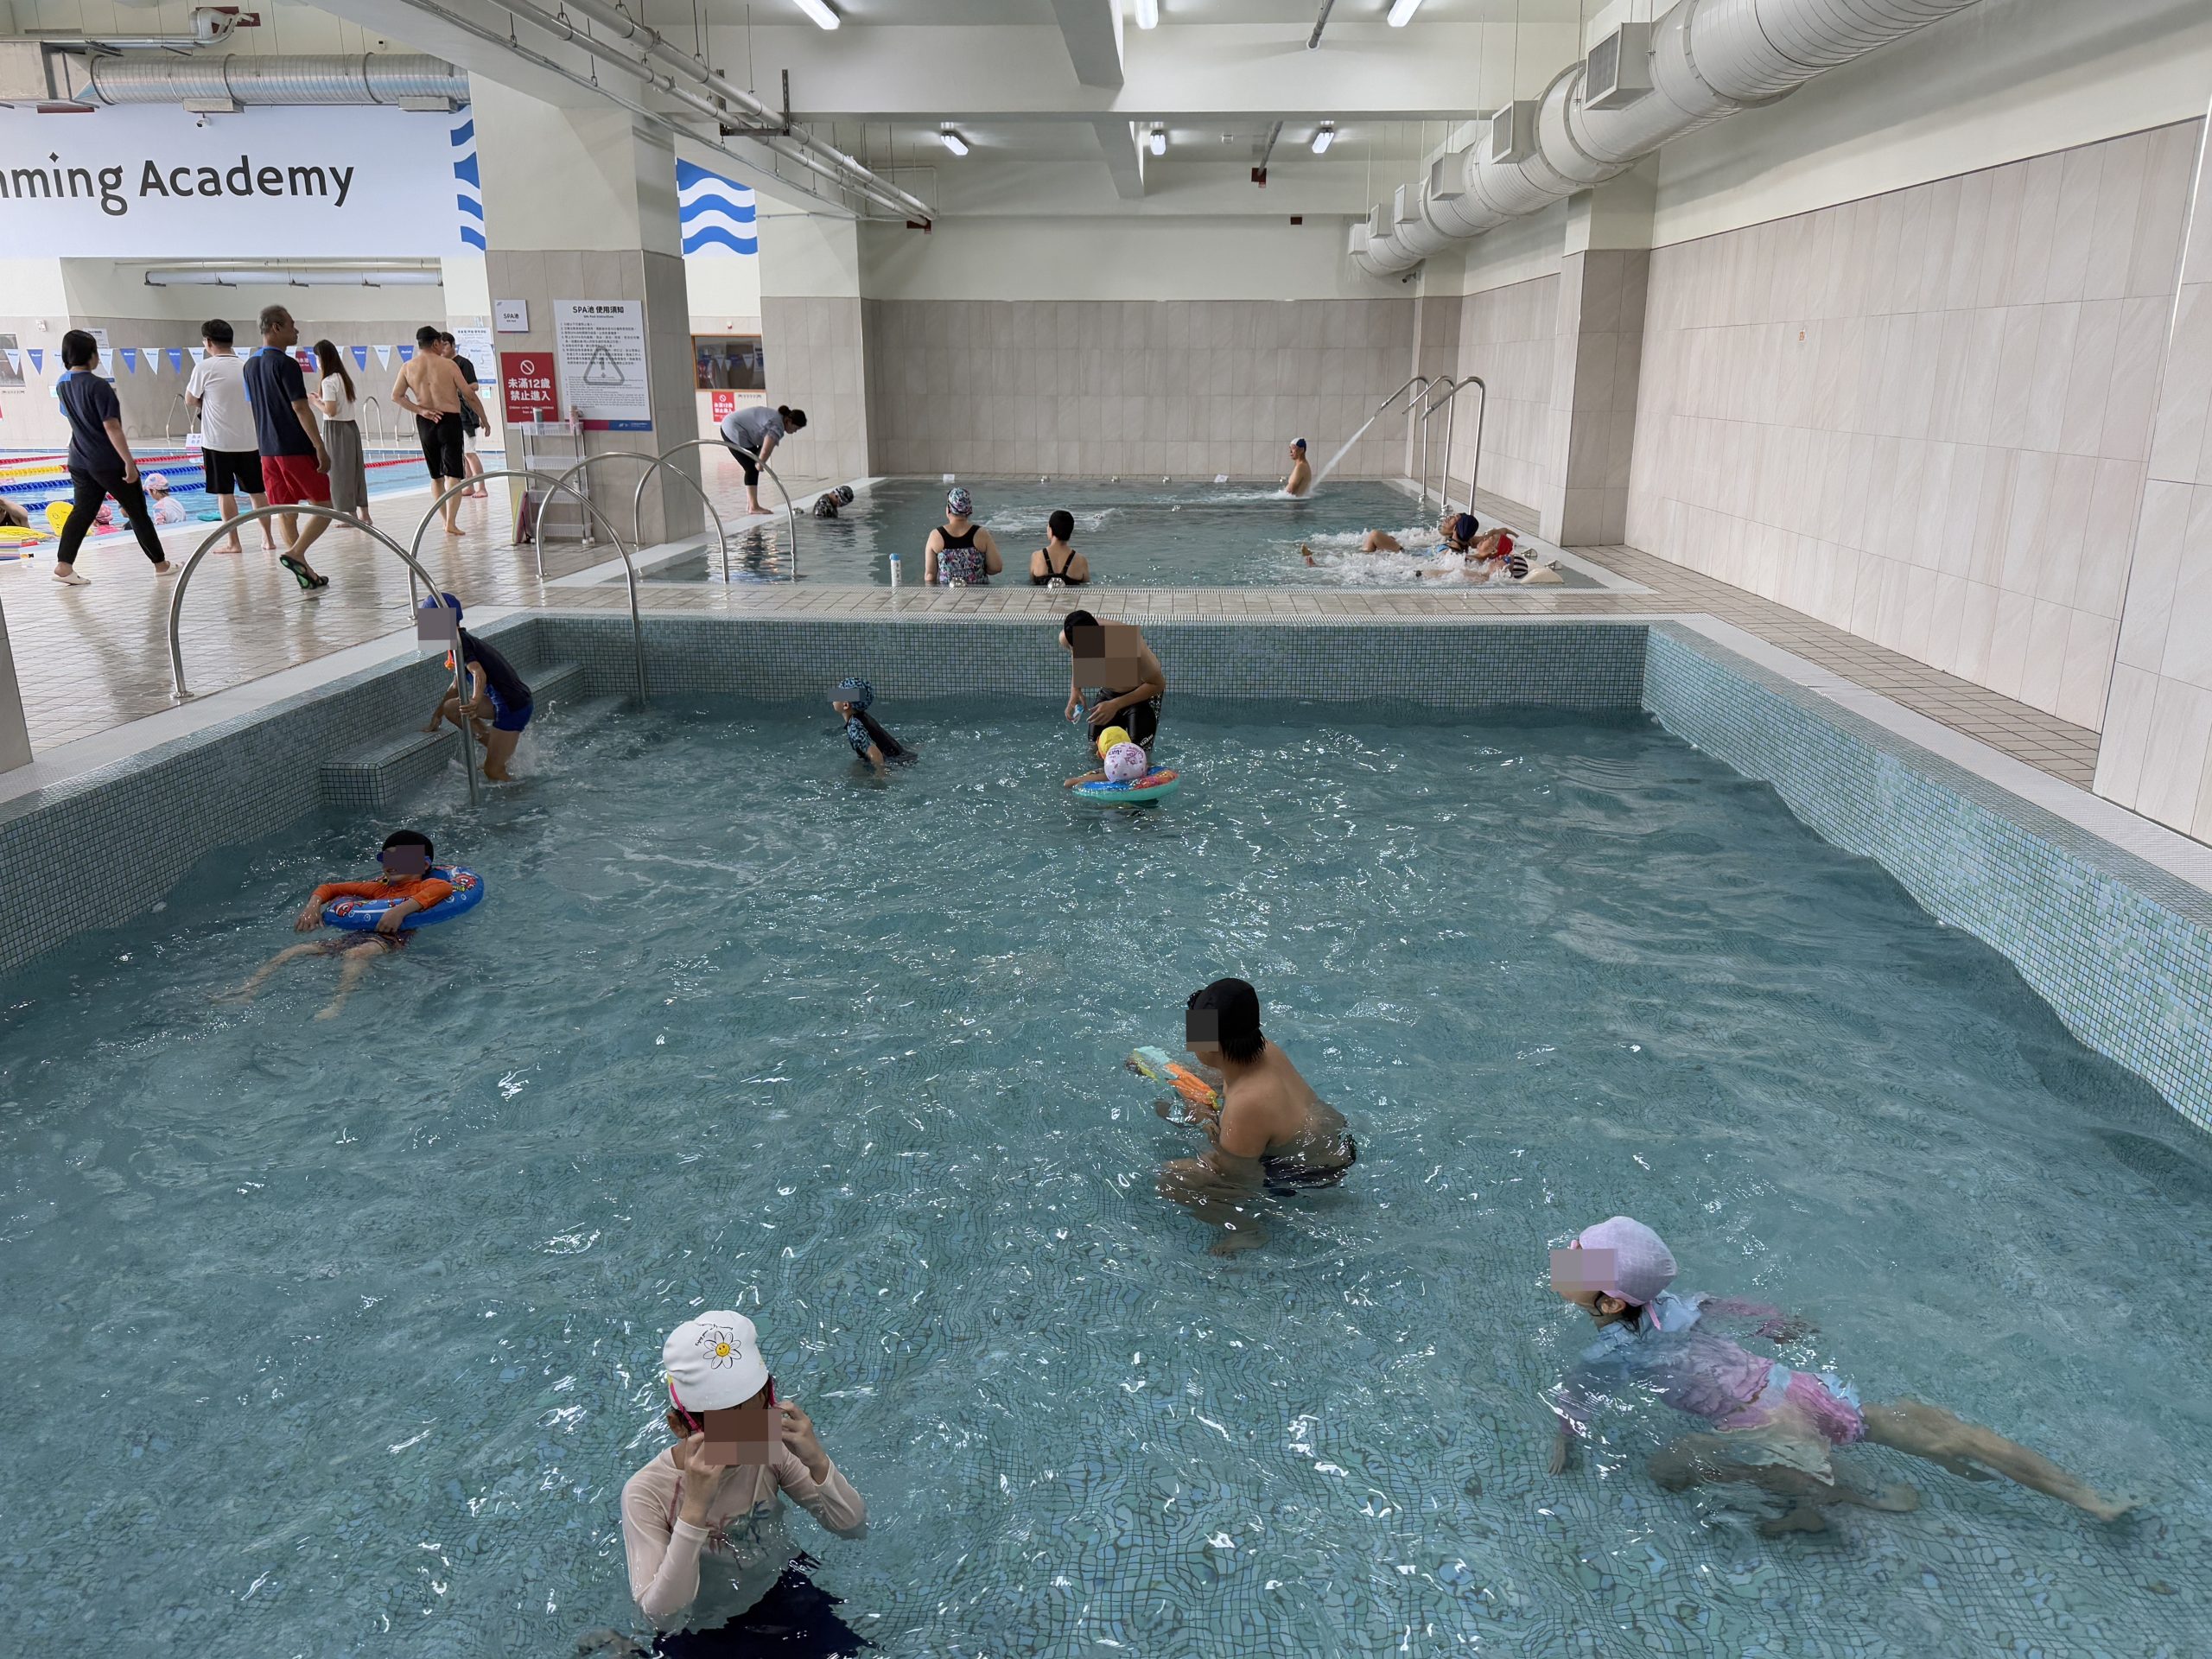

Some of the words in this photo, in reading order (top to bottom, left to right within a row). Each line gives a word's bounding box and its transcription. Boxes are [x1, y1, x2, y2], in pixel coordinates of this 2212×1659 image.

[0, 151, 128, 216] ming
[139, 155, 354, 207] Academy
[573, 305, 594, 314] SPA池
[596, 305, 624, 314] 使用須知
[508, 378, 550, 389] 未滿12歲
[510, 391, 550, 401] 禁止進入
